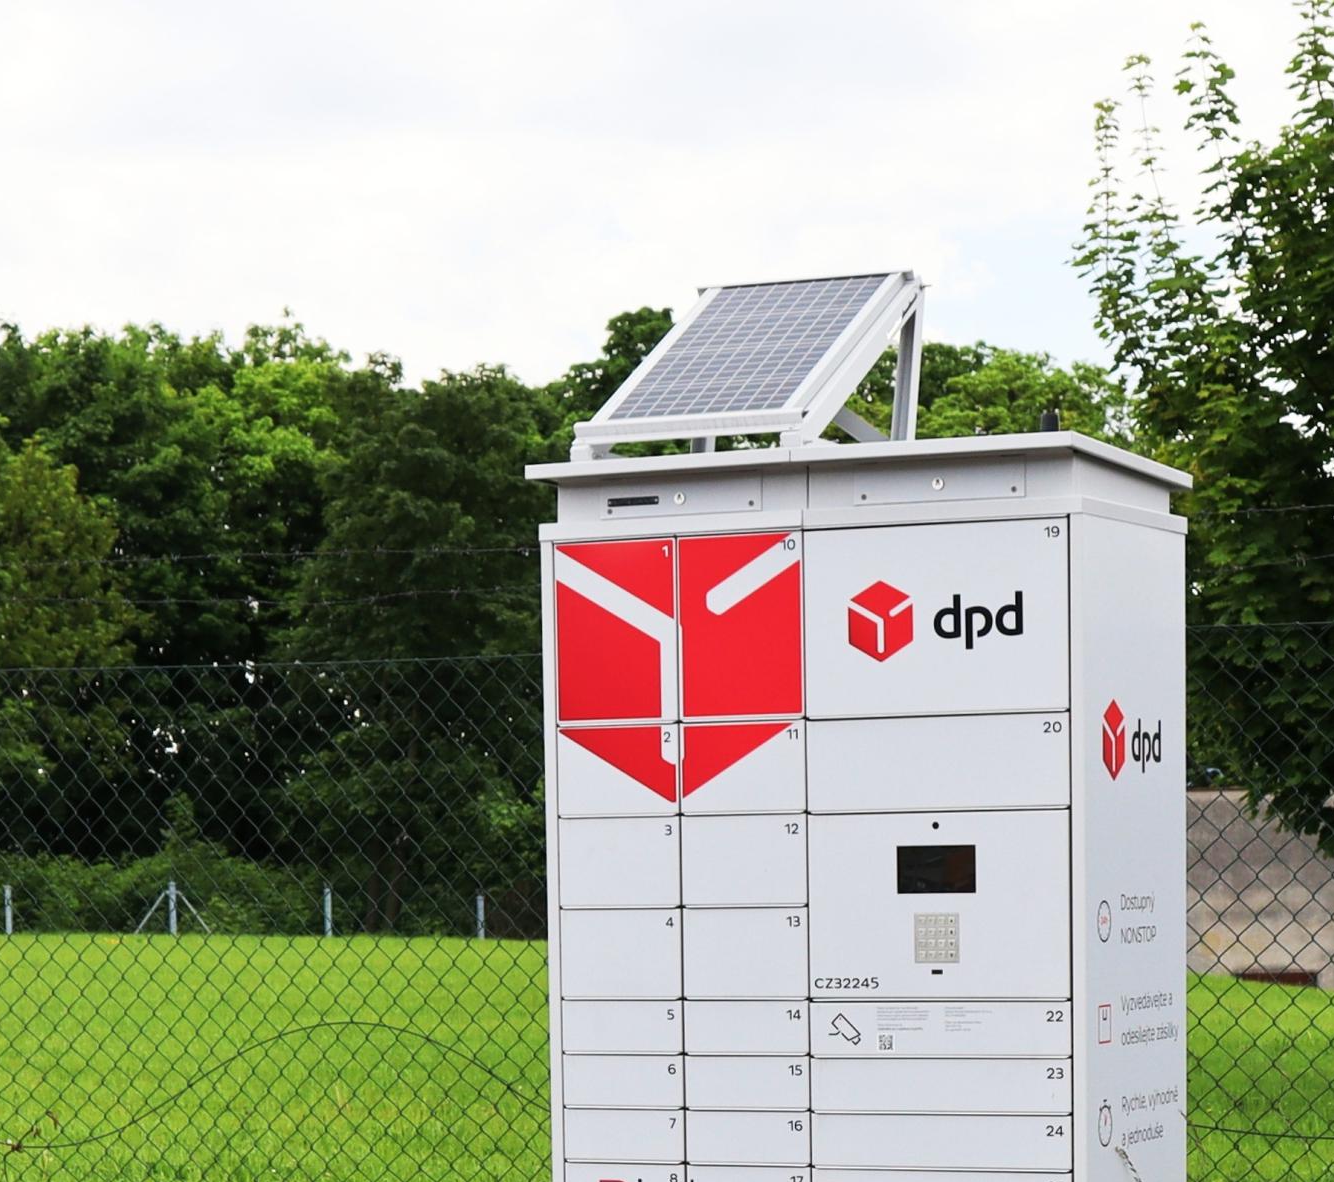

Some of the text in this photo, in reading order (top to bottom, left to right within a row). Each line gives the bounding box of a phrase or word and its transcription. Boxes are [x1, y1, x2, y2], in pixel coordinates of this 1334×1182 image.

[1043, 525, 1061, 538] 19
[661, 544, 669, 558] 1
[780, 538, 796, 551] 10
[933, 590, 1024, 650] dpd
[1042, 720, 1063, 734] 20
[663, 730, 672, 743] 2
[786, 727, 799, 741] 11
[1131, 718, 1162, 774] dpd
[664, 824, 673, 837] 3
[784, 822, 799, 835] 12
[665, 916, 675, 928] 4
[786, 915, 801, 928] 13
[1120, 925, 1156, 944] NONSTOP
[814, 976, 880, 990] CZ32245
[666, 1008, 675, 1021] 5
[786, 1008, 802, 1021] 14
[1045, 1009, 1064, 1023] 22
[667, 1063, 677, 1076] 6
[788, 1064, 803, 1077] 15
[1046, 1067, 1065, 1080] 23
[669, 1117, 677, 1129] 7
[787, 1119, 804, 1132] 16
[1045, 1124, 1065, 1137] 24
